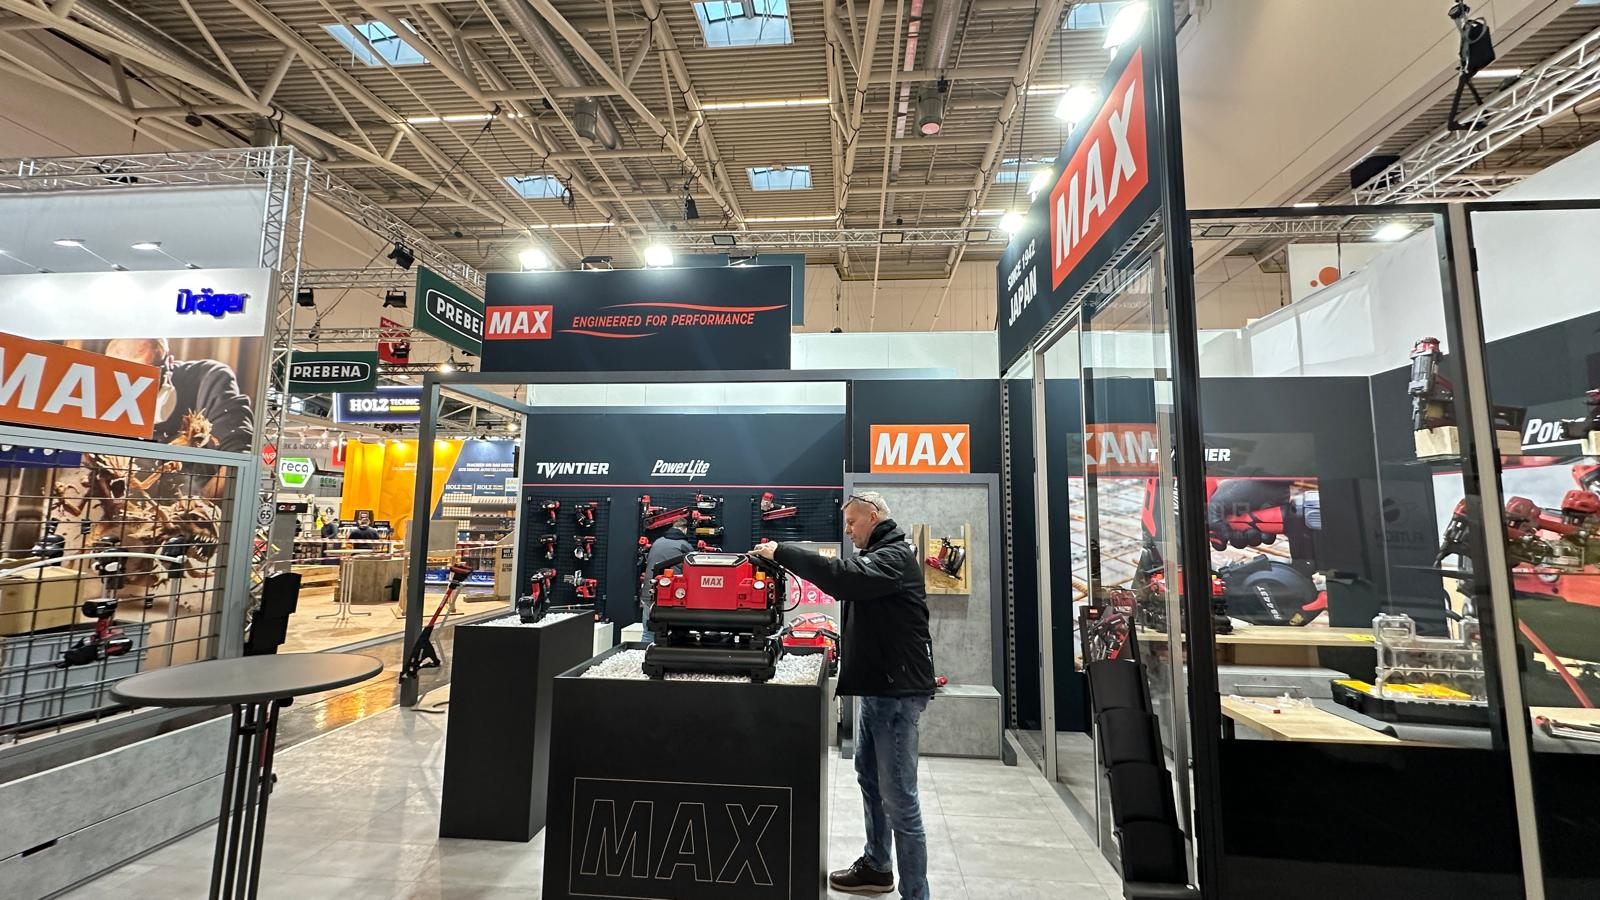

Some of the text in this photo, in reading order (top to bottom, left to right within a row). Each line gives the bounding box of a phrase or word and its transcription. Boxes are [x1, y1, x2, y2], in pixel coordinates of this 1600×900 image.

[1055, 79, 1137, 271] MAX
[1007, 238, 1036, 292] SINCE 1942
[176, 287, 251, 319] Dräger
[1008, 265, 1037, 327] JAPAN
[488, 310, 550, 334] MAX
[572, 312, 755, 328] ENGINEERED FOR PERFORMANCE
[292, 365, 362, 378] PREBENA
[0, 346, 155, 426] MAX
[349, 398, 390, 412] HOLZ
[874, 432, 966, 466] MAX
[280, 462, 309, 473] reca
[536, 462, 610, 479] TWINTIER
[651, 459, 711, 481] PowerLite
[702, 577, 723, 587] MAX
[579, 799, 779, 886] MAX
